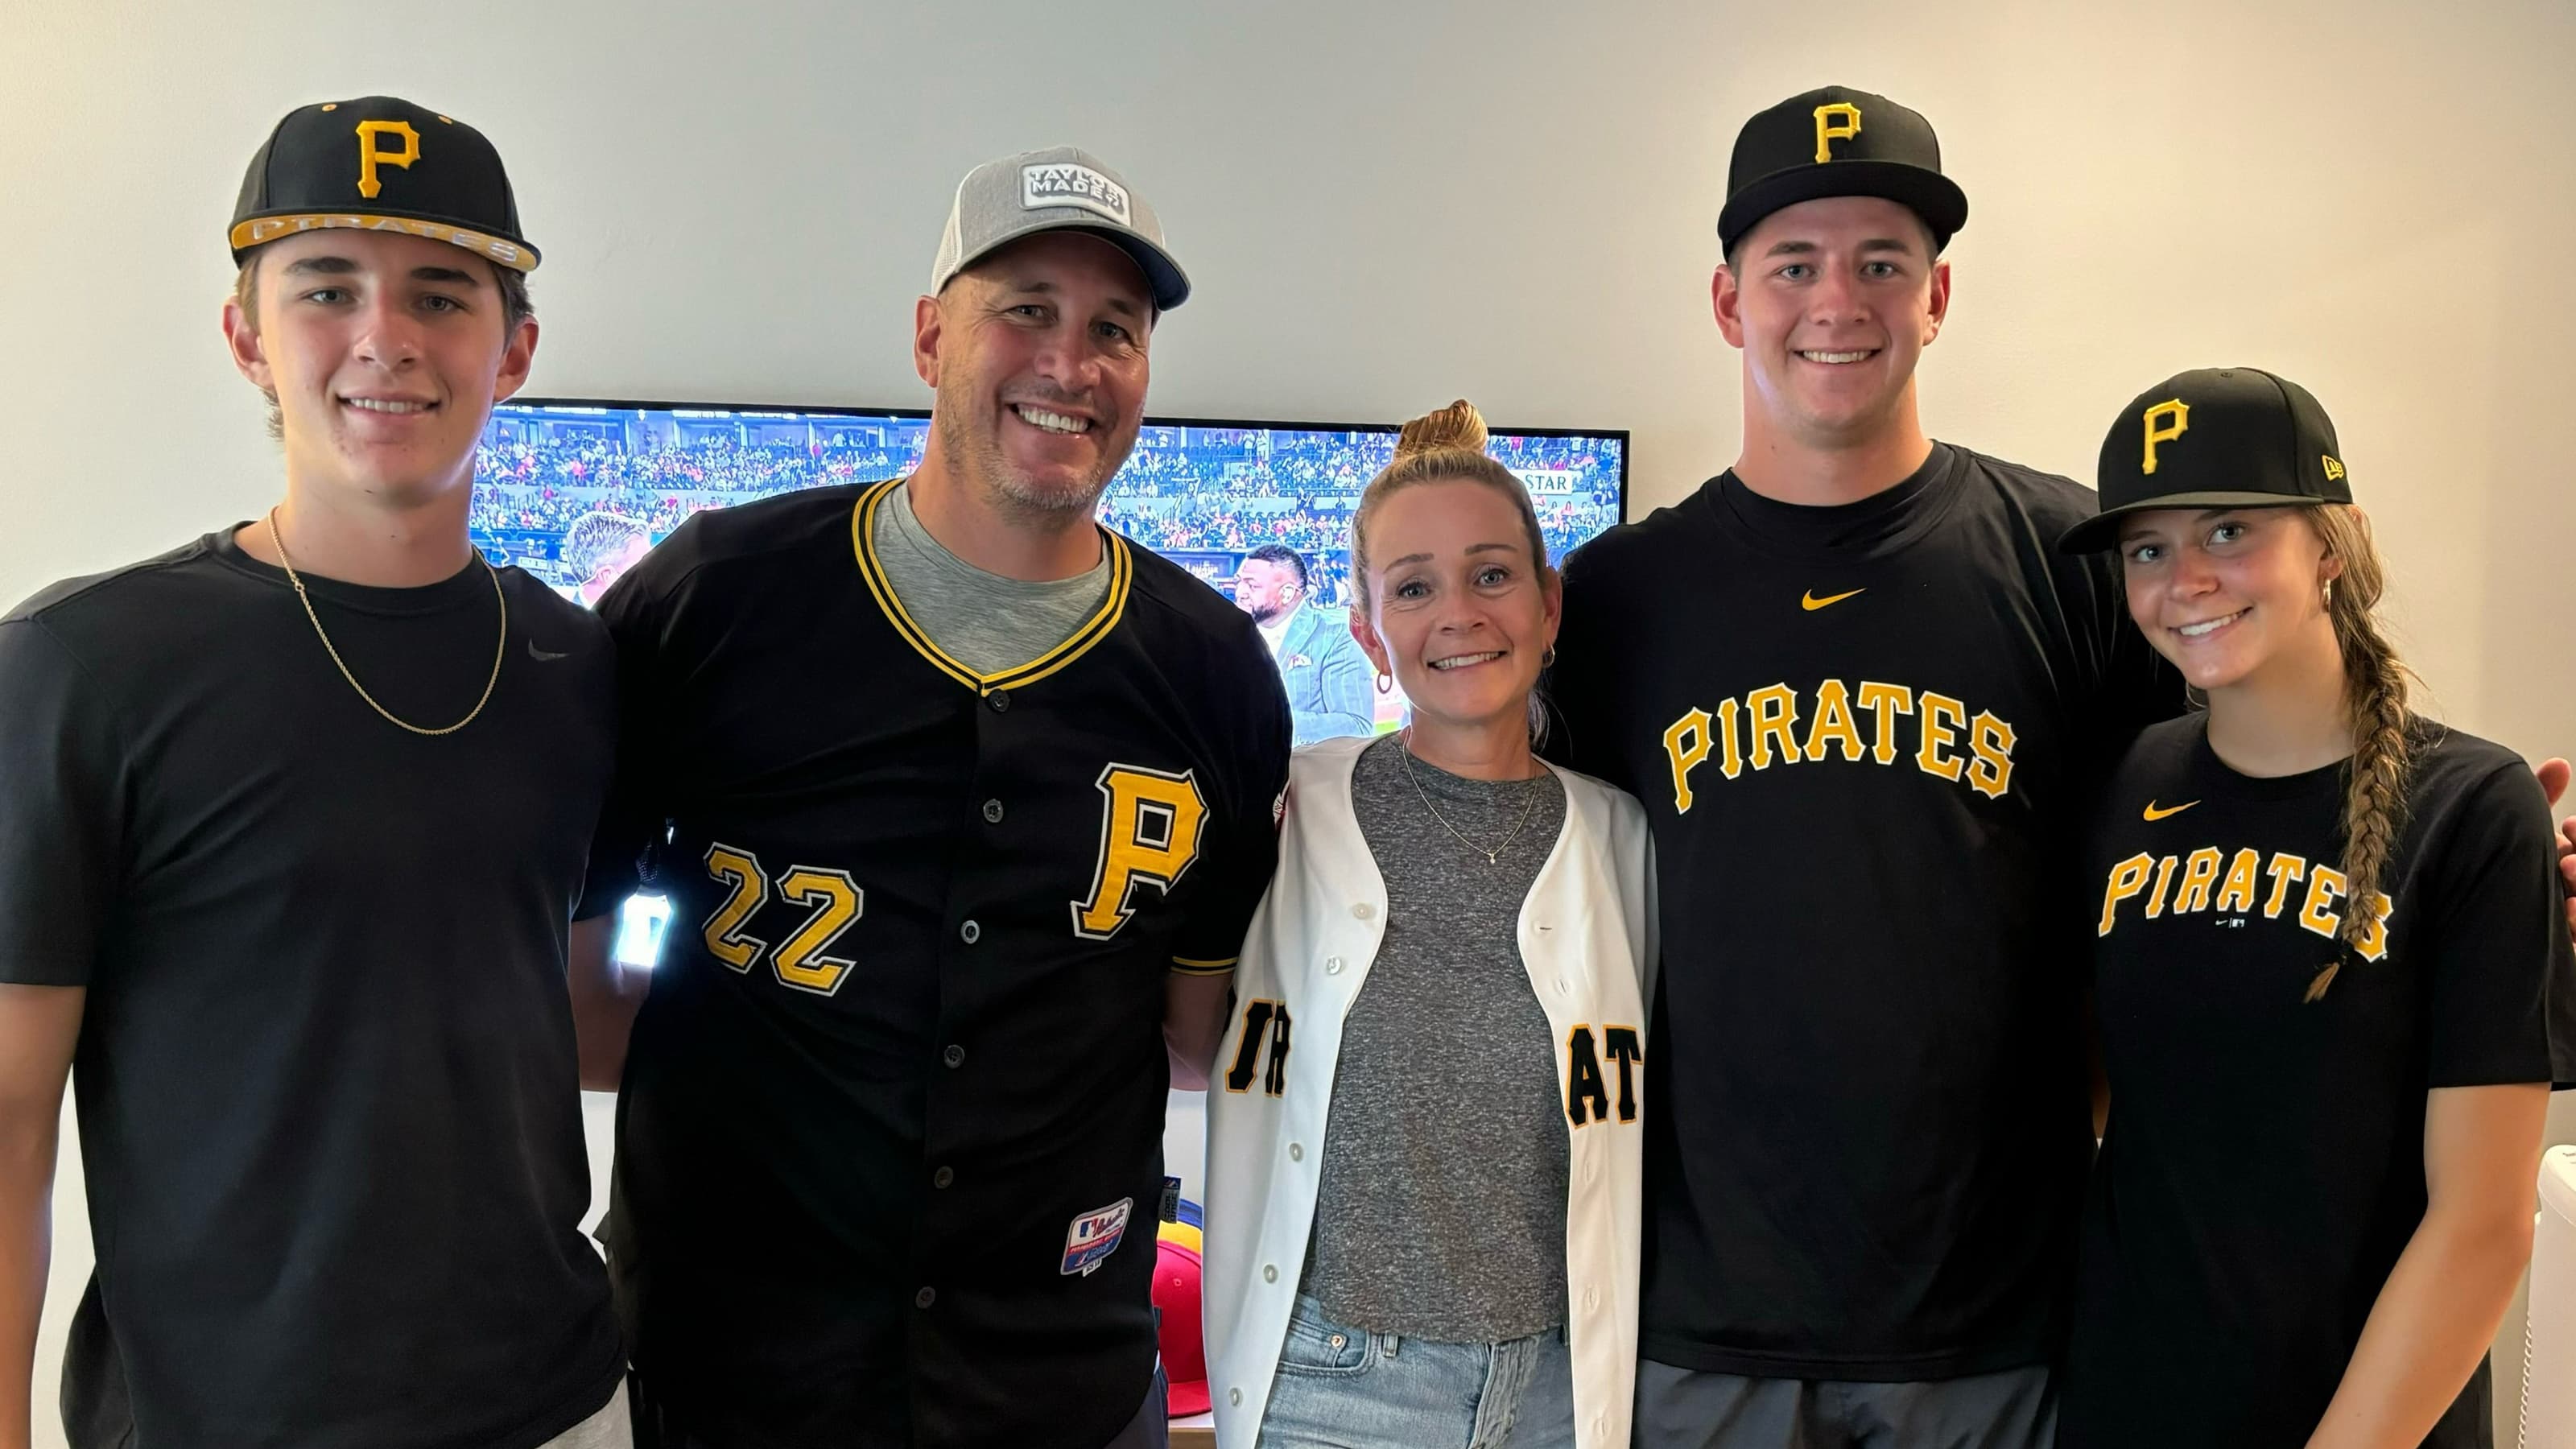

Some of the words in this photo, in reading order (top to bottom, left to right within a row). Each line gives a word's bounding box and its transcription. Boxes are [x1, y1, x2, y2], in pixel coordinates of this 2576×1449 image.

[355, 120, 420, 199] P
[1814, 102, 1861, 163] P
[1030, 167, 1120, 200] TAYLOR
[2142, 398, 2190, 475] P
[1525, 473, 1567, 491] STAR
[1663, 679, 2018, 815] PIRATES
[1070, 762, 1210, 941] P
[701, 841, 864, 997] 22
